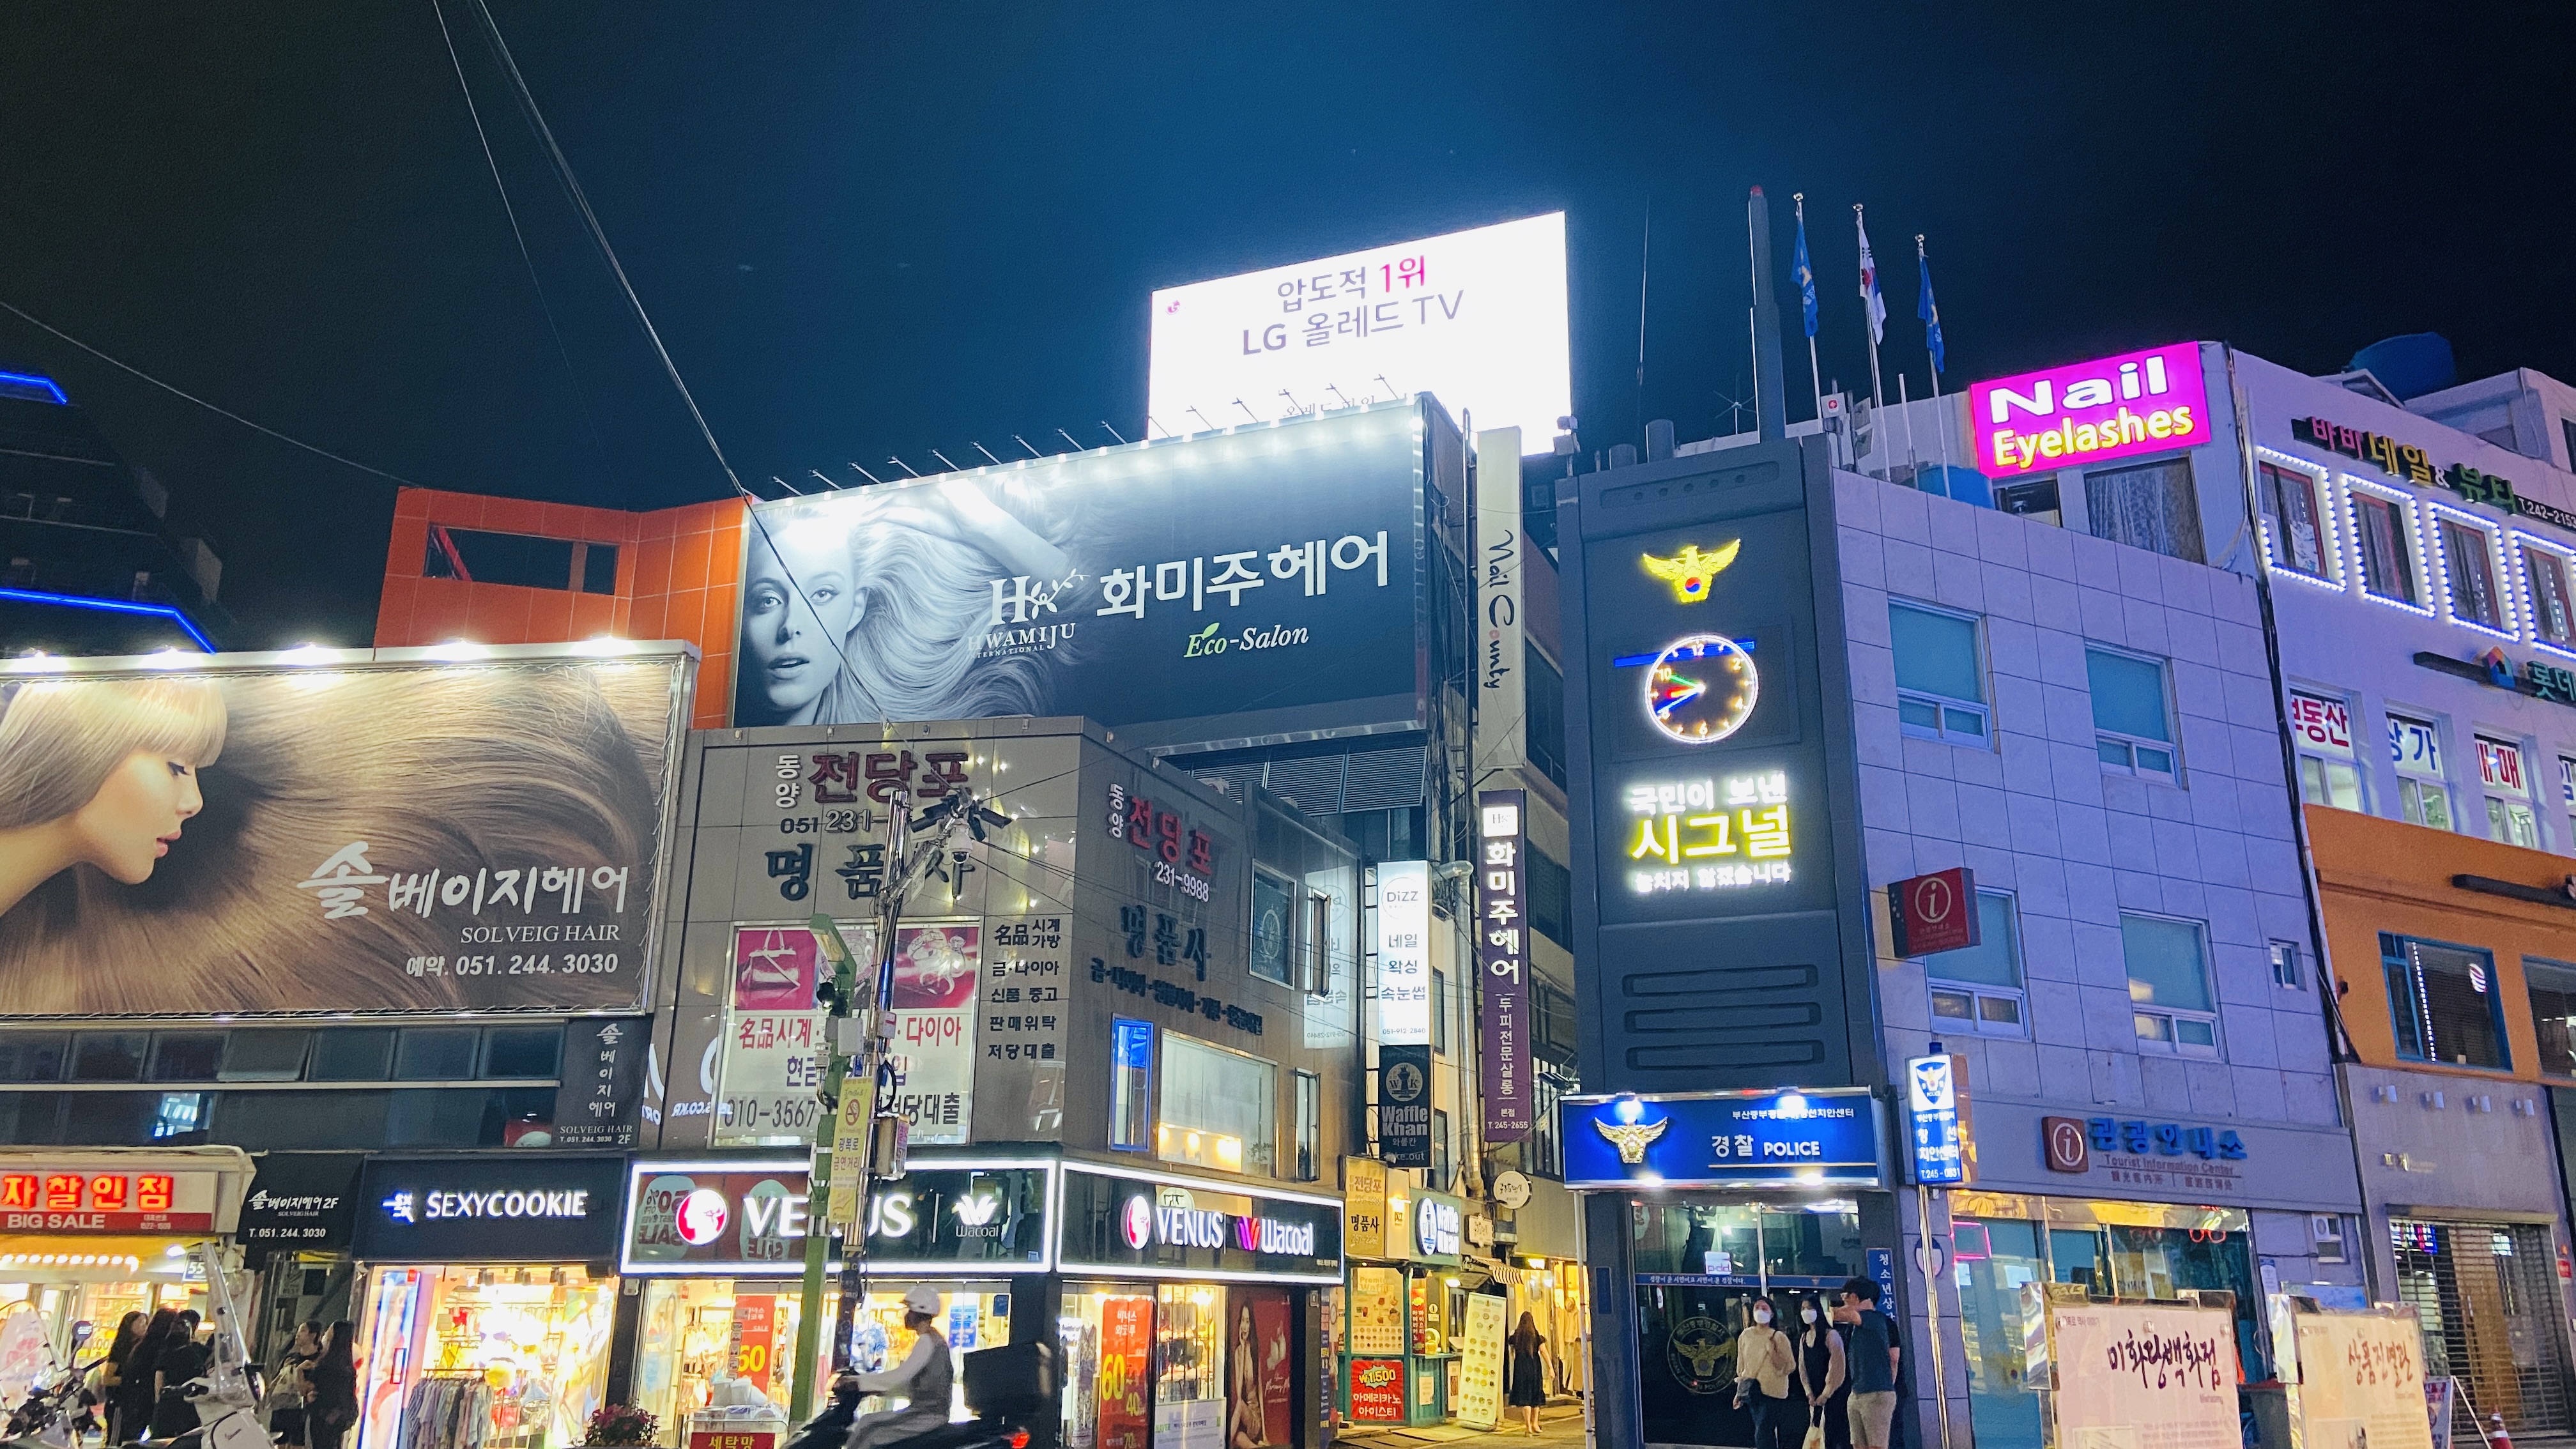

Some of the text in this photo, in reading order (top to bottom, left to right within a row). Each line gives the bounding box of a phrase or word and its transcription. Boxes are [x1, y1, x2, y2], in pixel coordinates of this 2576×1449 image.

[1278, 255, 1425, 312] 압도적 1위
[1243, 289, 1464, 355] LG 올레드 TV
[1989, 354, 2168, 424] Nail
[1993, 404, 2194, 470] Eyelashes
[1489, 530, 1514, 588] Nail
[968, 623, 1076, 651] HWAMIJU
[1184, 624, 1309, 658] Eco-Salon
[775, 755, 801, 808] 동양
[808, 750, 972, 804] 전당포
[1630, 780, 1714, 815] 국민이
[1109, 783, 1124, 838] 동양
[780, 817, 818, 834] 051
[1128, 796, 1212, 875] 전당포
[1632, 805, 1791, 864] 시그널
[296, 841, 629, 919] 솔베이지헤어
[1157, 861, 1209, 903] 231-9988
[1387, 891, 1418, 902] DiZZ
[1486, 842, 1519, 986] 화미주헤어
[461, 924, 620, 944] SOLVEIG HAIR
[994, 919, 1061, 946] 名品 시계
[1032, 935, 1061, 949] 가방
[1388, 934, 1418, 948] 네일
[562, 953, 618, 974] 3030
[1388, 960, 1418, 974] 왁싱
[992, 988, 1057, 1003] 신품 중고
[1381, 986, 1425, 1001] 속눈썹
[1499, 998, 1514, 1095] 두피전문살롱
[588, 1023, 624, 1117] 솔베이지헤어
[1381, 1105, 1428, 1123] Waffle
[1501, 1108, 1515, 1117] 본점
[560, 1125, 632, 1134] SOLVEIG HAIR
[617, 1135, 631, 1144] 2F
[1383, 1122, 1427, 1136] Khan
[839, 1137, 859, 1151] 광복로
[1712, 1133, 1821, 1158] 경찰 POLICE
[834, 1156, 861, 1170] 금연거리
[2104, 1154, 2234, 1175] Tourist Information Center
[1354, 1176, 1382, 1193] 전당포
[323, 1197, 339, 1209] 2F
[426, 1191, 588, 1217] SEXYCOOKIE
[744, 1193, 999, 1238] VES Wacoal
[8, 1214, 106, 1229] BIG SALE
[1351, 1214, 1380, 1234] 명품사
[1436, 1204, 1459, 1233] Waffle
[303, 1229, 326, 1238] 3030
[1156, 1207, 1314, 1257] VENUS Wacoal
[1117, 1310, 1137, 1322] 비너스
[739, 1344, 766, 1372] 60
[1102, 1353, 1125, 1400] 60
[1353, 1392, 1402, 1405] 아메리카노
[1358, 1404, 1397, 1418] 아이스티
